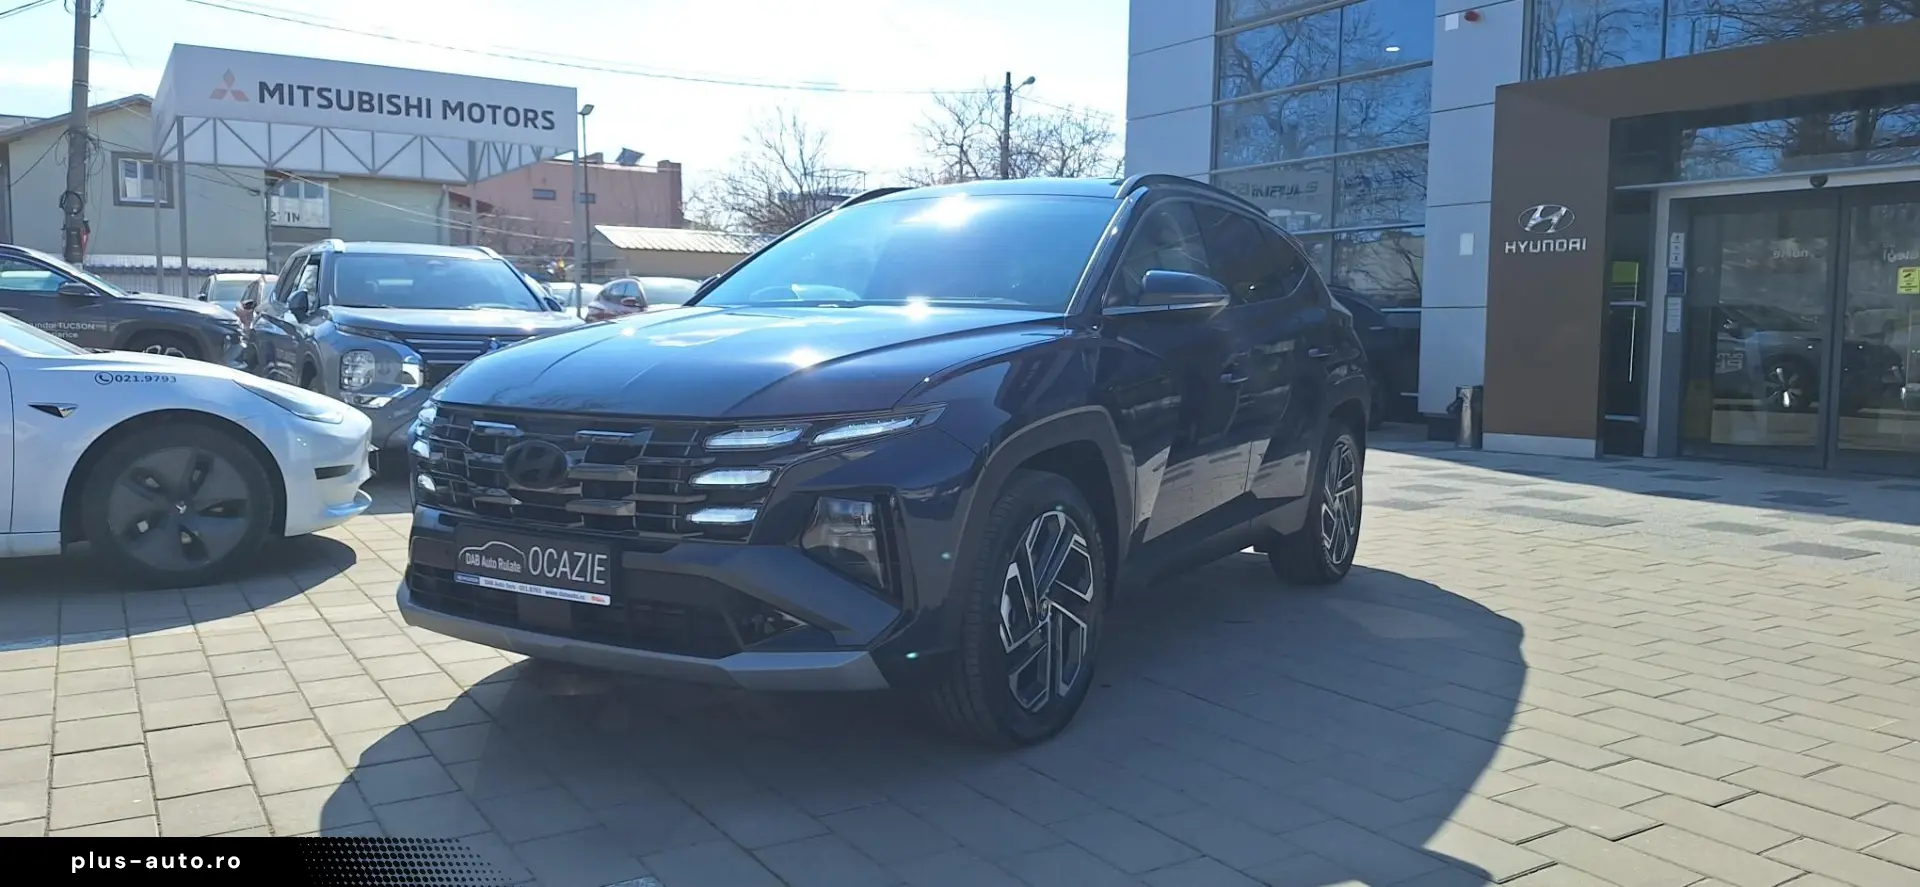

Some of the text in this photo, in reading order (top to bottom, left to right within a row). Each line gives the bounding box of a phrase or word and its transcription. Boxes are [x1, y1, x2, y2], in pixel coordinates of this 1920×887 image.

[258, 81, 556, 131] MITSUBISHI MOTORS
[1505, 238, 1587, 254] HYUNDAI
[58, 322, 96, 331] TUCSON
[115, 374, 177, 384] 021.9793
[465, 552, 522, 573] DAB Auto Rulate
[528, 546, 608, 584] OCAZIE
